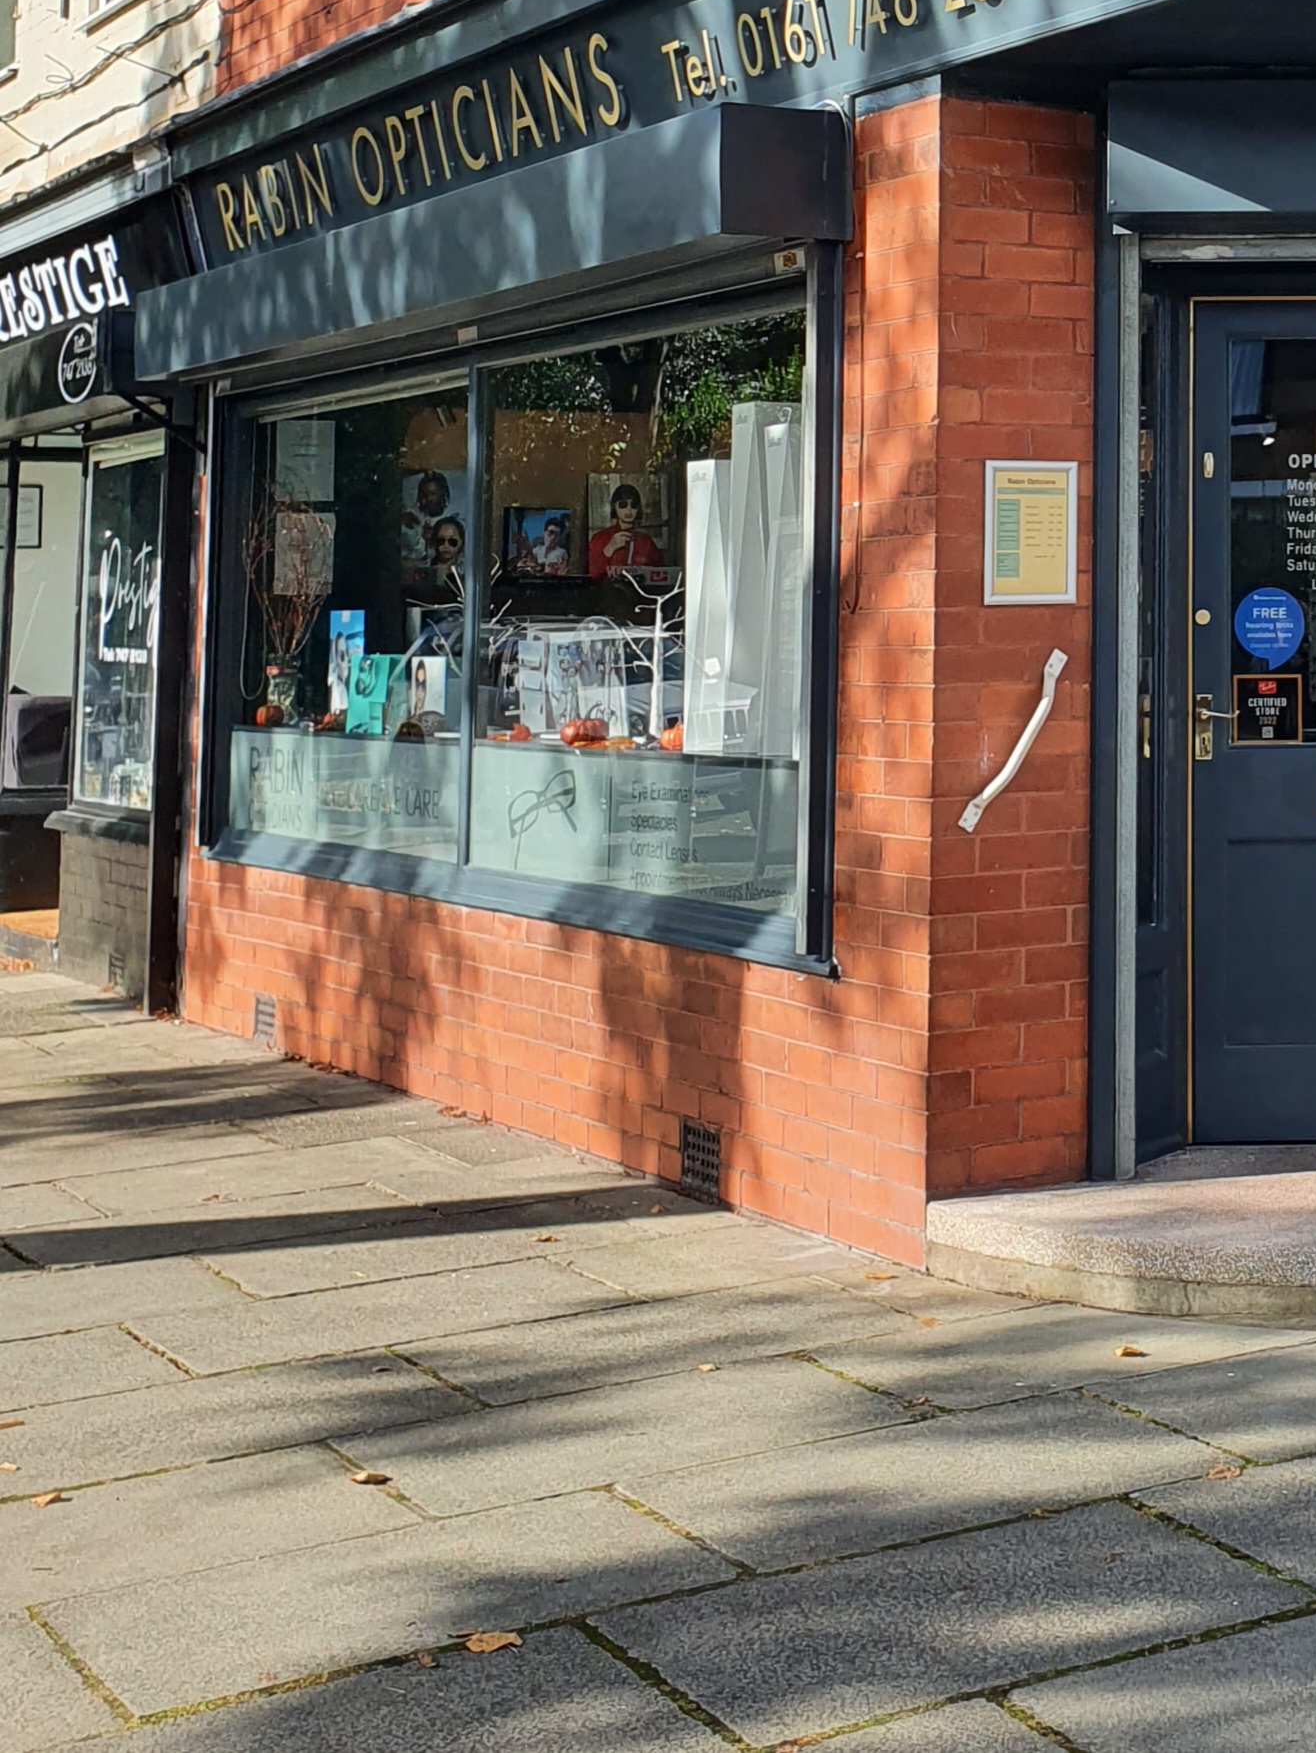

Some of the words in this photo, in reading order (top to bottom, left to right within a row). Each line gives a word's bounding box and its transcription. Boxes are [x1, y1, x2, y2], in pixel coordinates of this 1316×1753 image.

[214, 143, 334, 252] RABIN
[351, 32, 622, 207] OPTICIANS
[661, 28, 728, 103] Tel.
[0, 234, 130, 342] ESTIGE
[1252, 607, 1288, 619] FREE
[1247, 697, 1288, 707] CERTIFIED
[1255, 707, 1280, 716] STORE
[249, 746, 305, 796] RABIN
[650, 780, 710, 803] Examinatons
[629, 809, 679, 832] Spectacles
[629, 837, 664, 858] Contact
